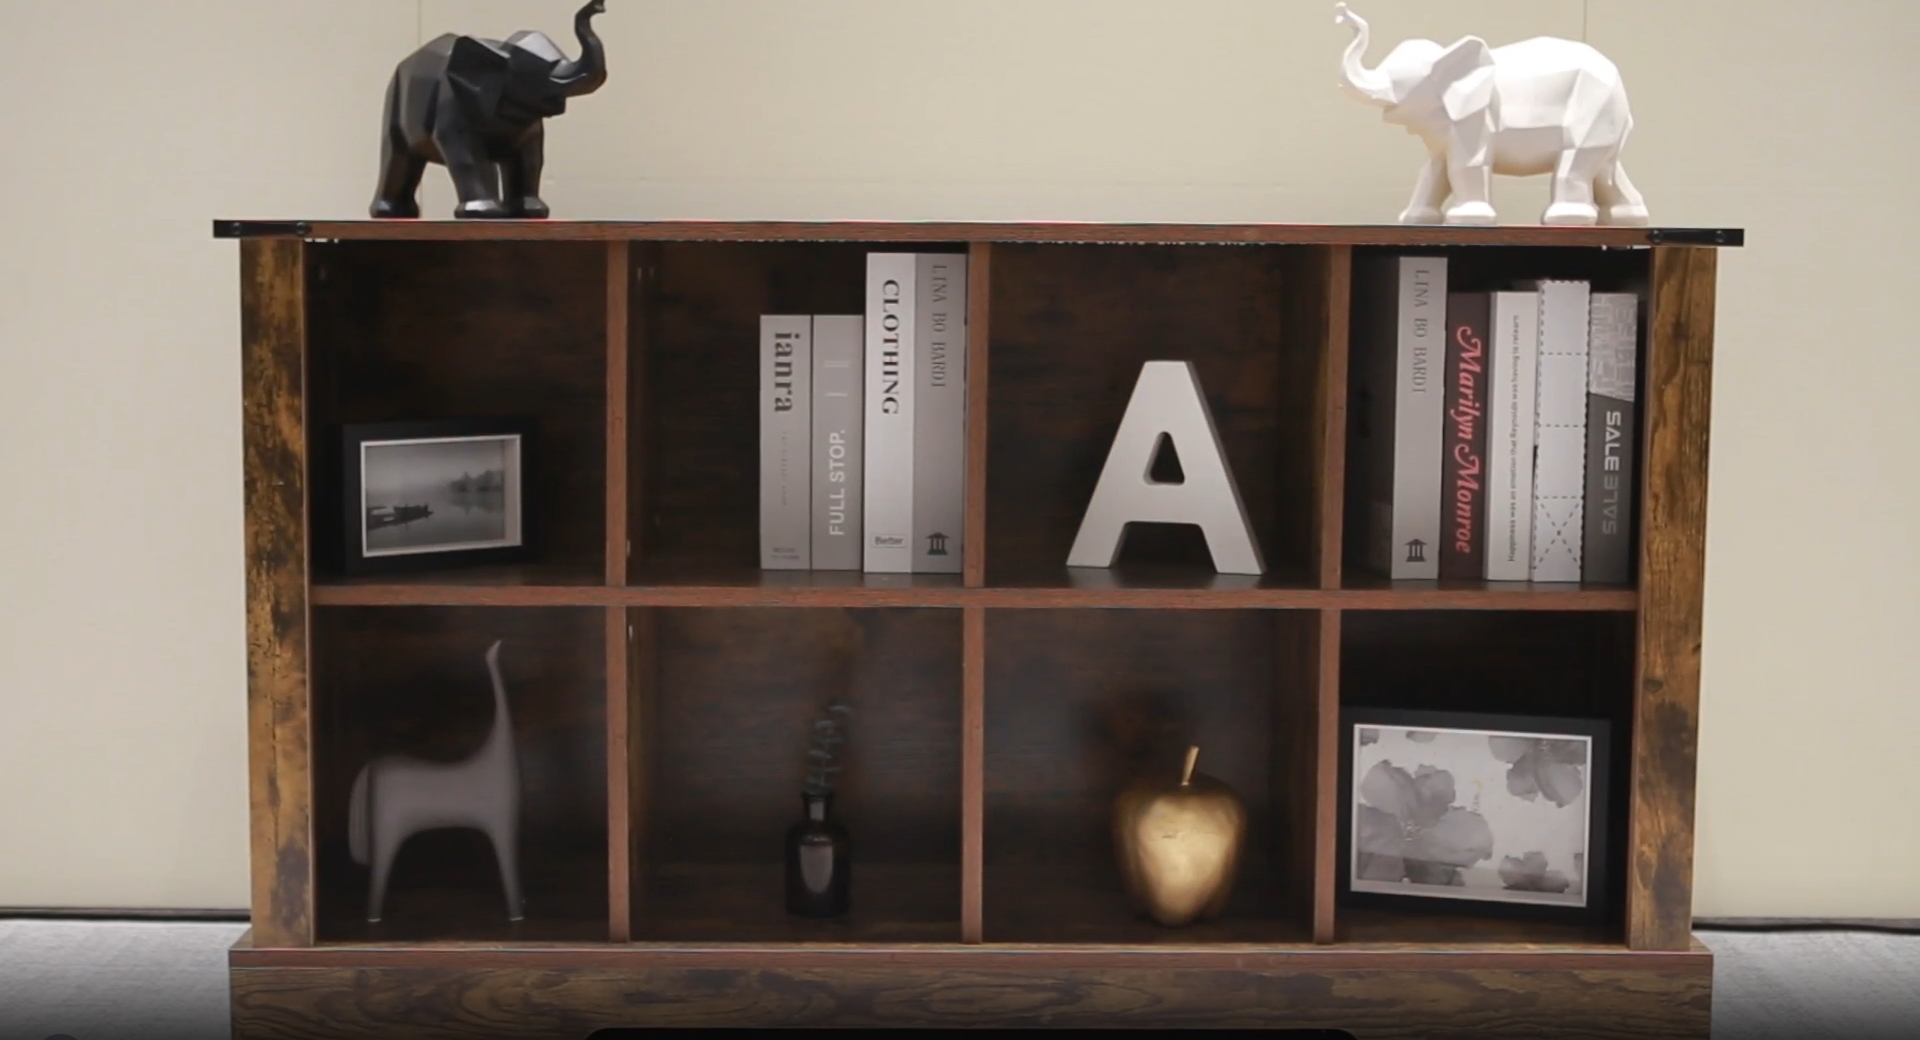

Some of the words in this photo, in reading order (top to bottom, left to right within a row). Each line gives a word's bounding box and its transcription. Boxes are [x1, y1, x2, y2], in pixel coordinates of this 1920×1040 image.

[932, 264, 947, 303] LINA
[1413, 269, 1430, 308] LINA
[881, 279, 901, 415] CLOTHING
[932, 313, 947, 332] BO
[1413, 318, 1428, 338] BO
[774, 332, 801, 413] ianra
[931, 342, 946, 388] BARDI
[1411, 346, 1427, 393] BARDI
[1450, 326, 1483, 438] Marilyn
[828, 429, 847, 482] STOP.
[1604, 410, 1621, 471] SALE
[1066, 360, 1266, 575] A
[828, 487, 845, 536] FULL
[1453, 445, 1480, 554] Monroe
[874, 535, 904, 547] Better
